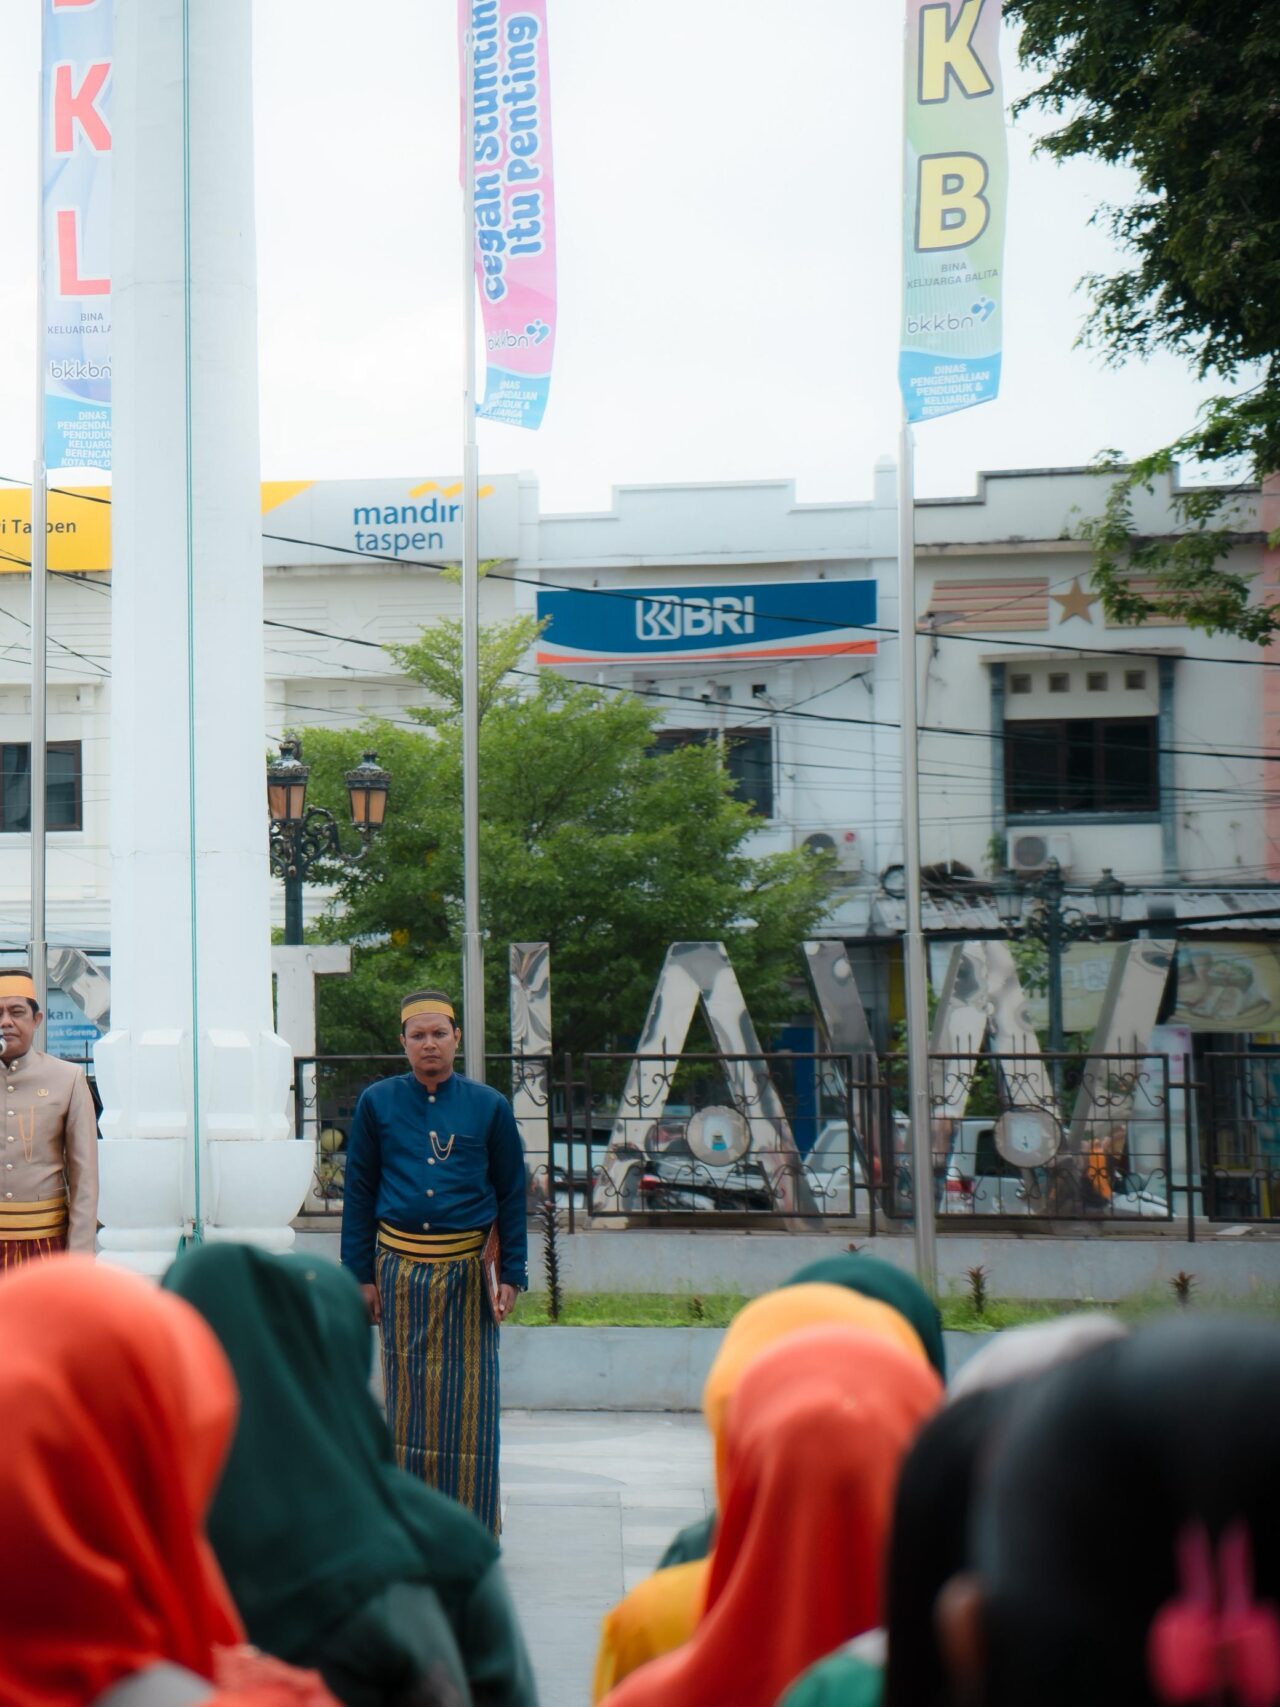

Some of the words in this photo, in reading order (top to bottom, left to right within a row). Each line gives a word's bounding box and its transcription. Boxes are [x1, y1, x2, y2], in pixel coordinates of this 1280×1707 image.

[506, 194, 542, 255] Itu
[941, 262, 967, 273] BINA
[906, 276, 962, 289] KELUARGA
[965, 268, 999, 283] BALITA
[80, 312, 104, 321] BINA
[907, 313, 974, 334] bkkbn
[47, 325, 99, 335] KELUARGA
[50, 361, 112, 378] bkkbn
[933, 364, 967, 375] DINAS
[910, 371, 990, 387] PENGENDALIAN
[916, 384, 974, 396] PENDUDUK
[923, 393, 977, 405] KELUARGA
[78, 411, 107, 420] DINAS
[61, 457, 85, 467] KOTA
[12, 519, 76, 535] Tapen
[355, 530, 443, 556] taspen
[683, 596, 754, 636] BRI
